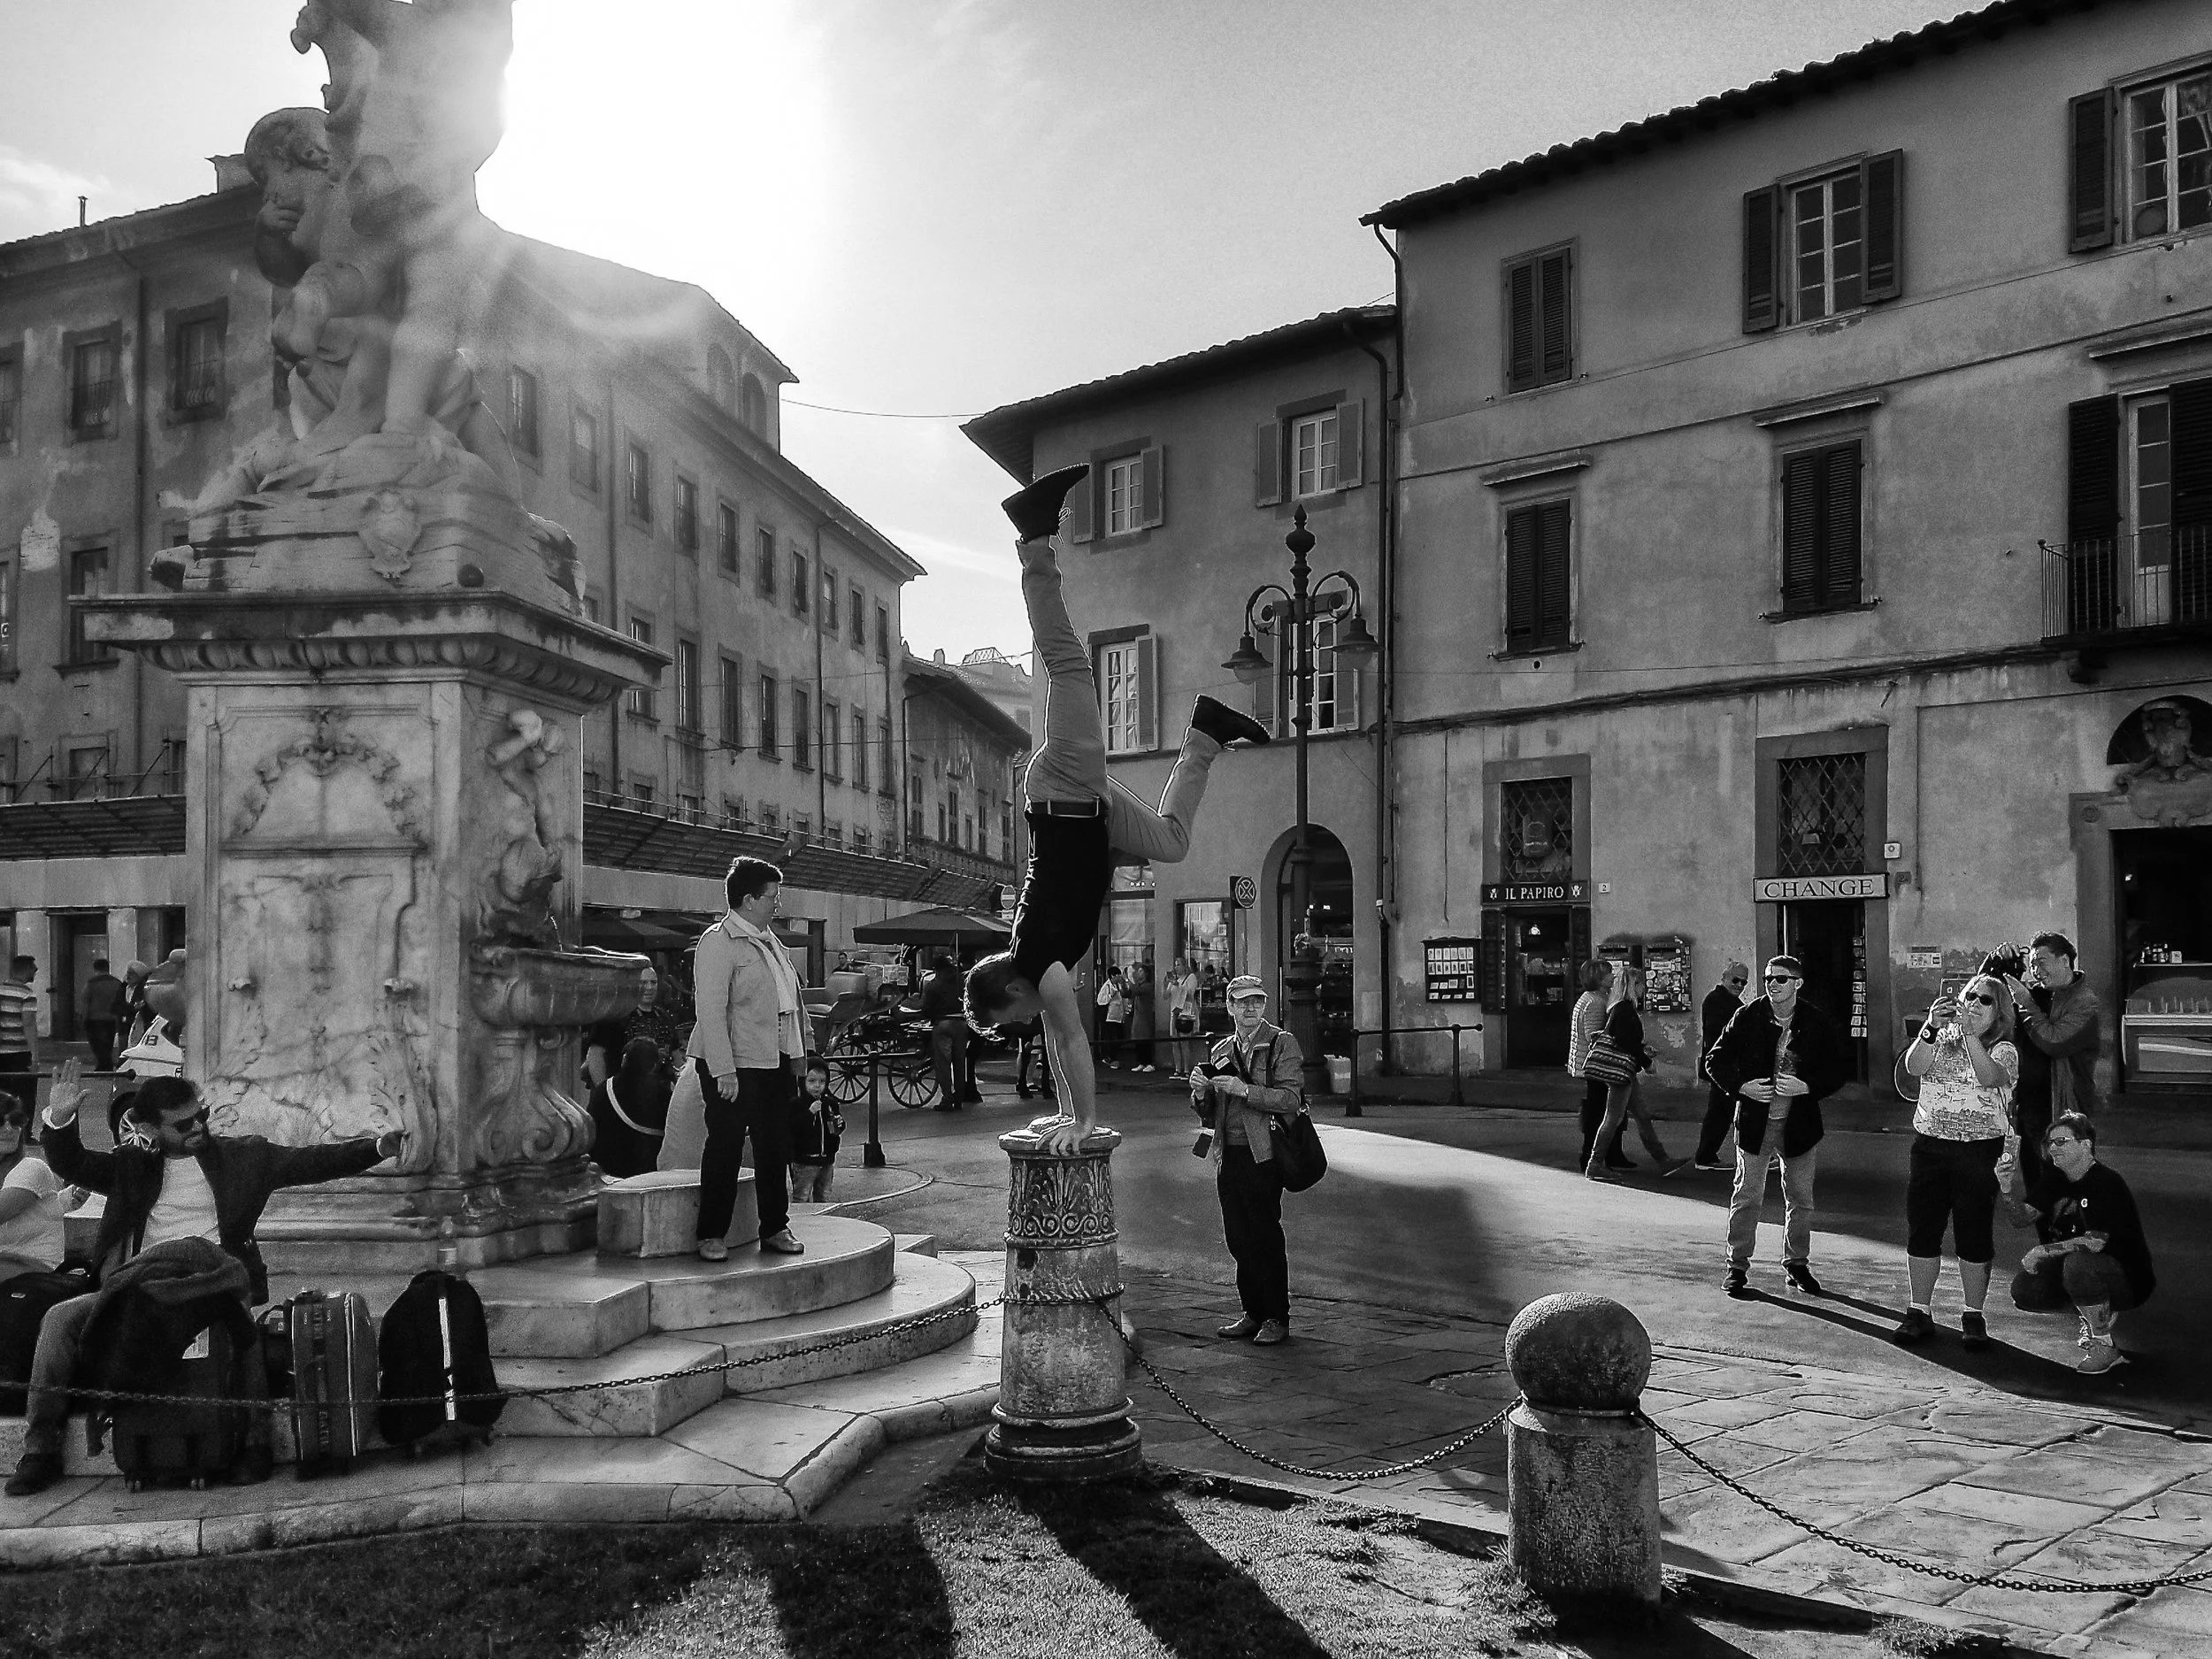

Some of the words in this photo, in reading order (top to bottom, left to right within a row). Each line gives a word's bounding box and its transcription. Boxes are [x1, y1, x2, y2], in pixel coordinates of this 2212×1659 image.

[1505, 887, 1516, 900] IL
[1520, 886, 1564, 900] PAPIRO
[1764, 879, 1874, 898] CHANGE
